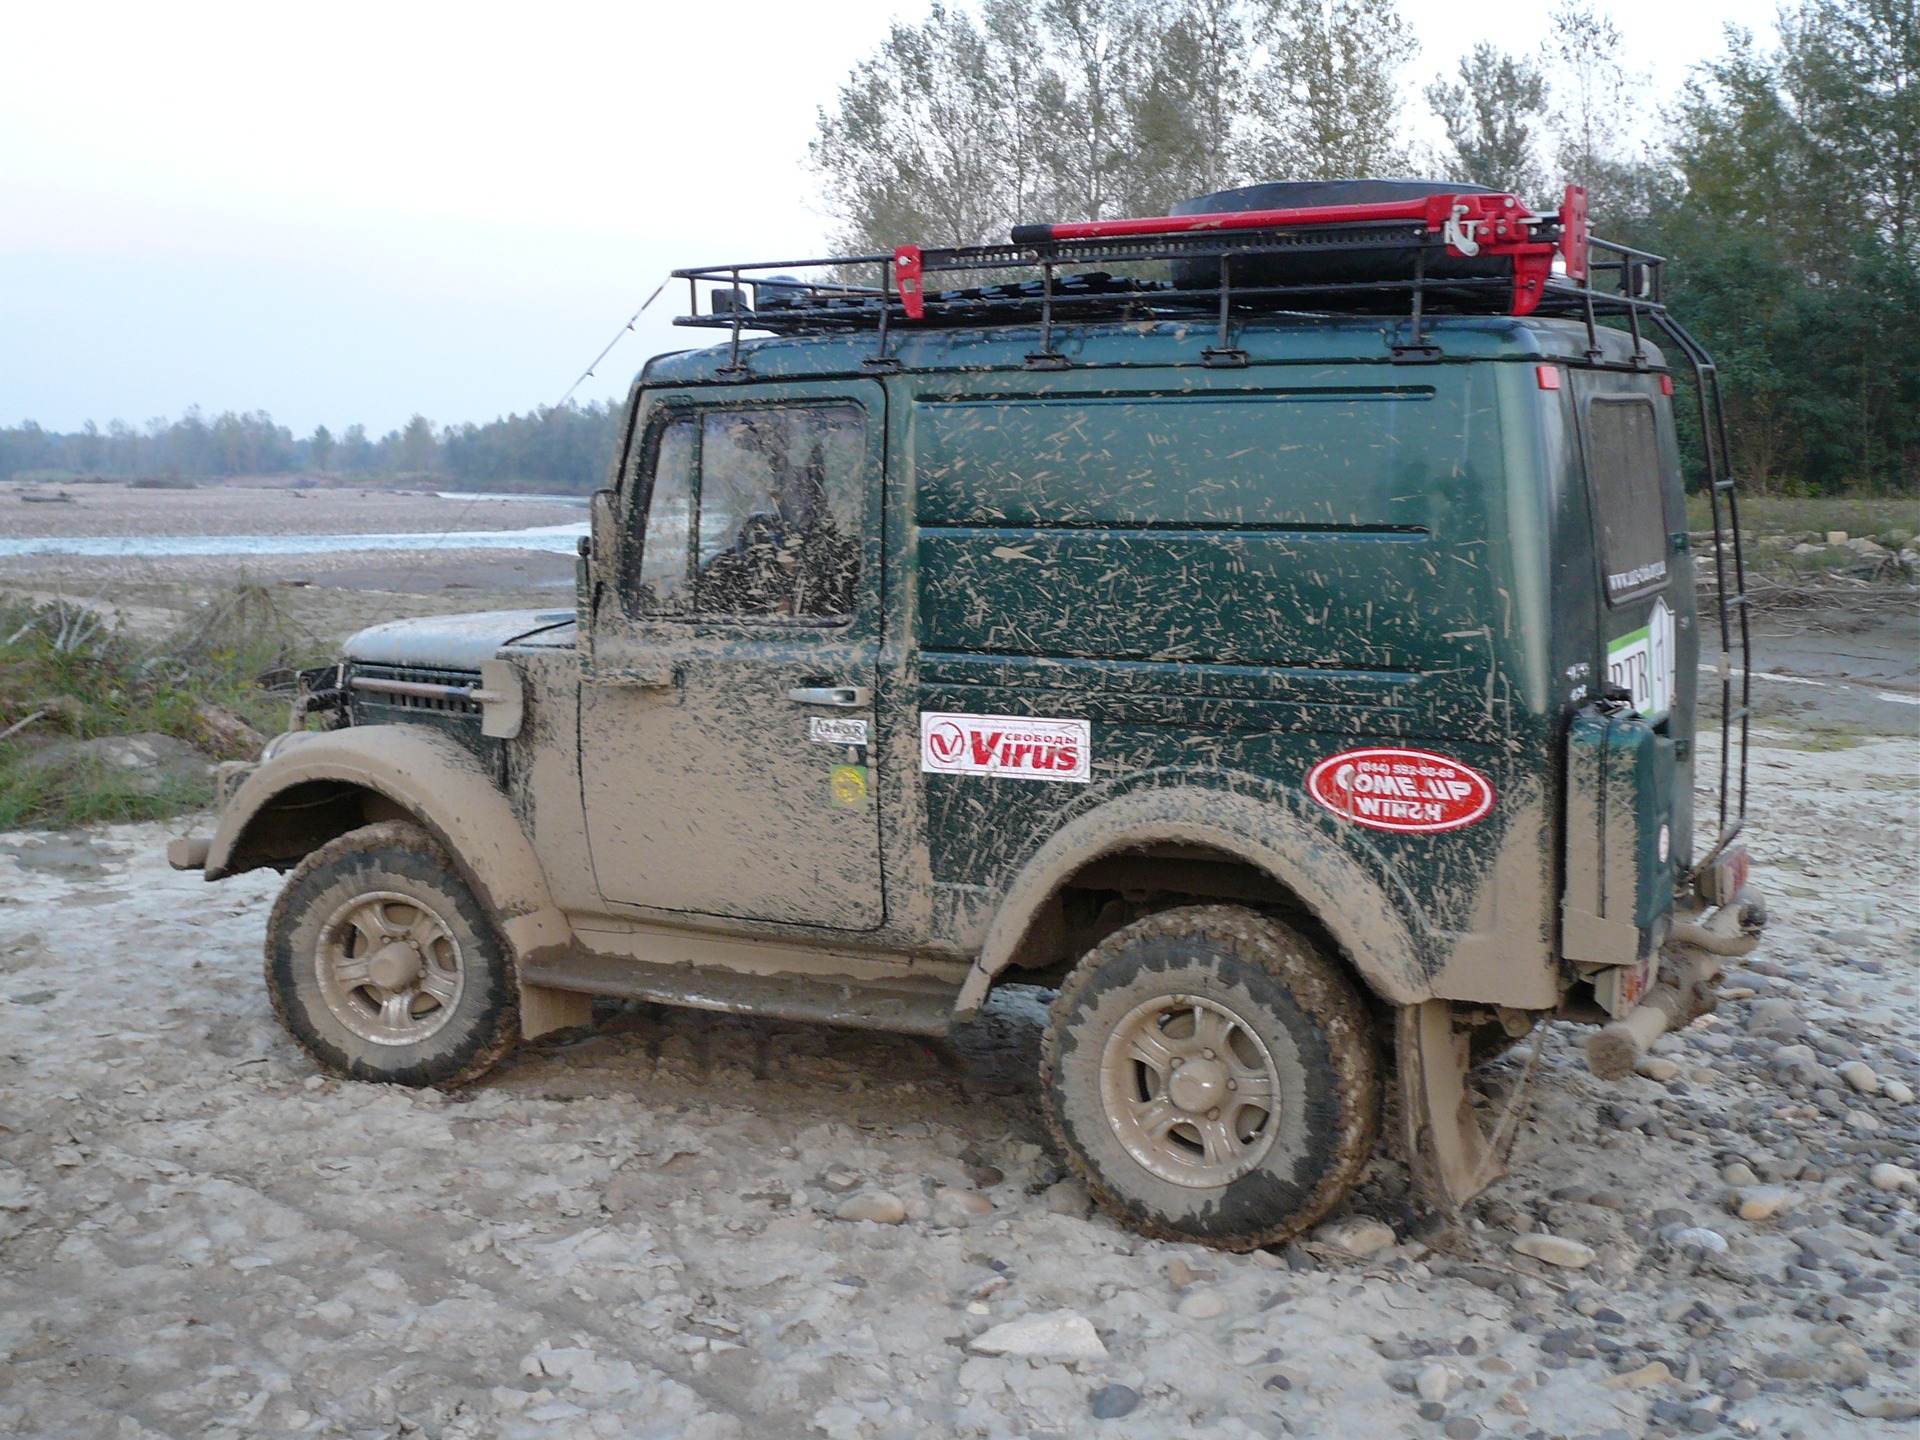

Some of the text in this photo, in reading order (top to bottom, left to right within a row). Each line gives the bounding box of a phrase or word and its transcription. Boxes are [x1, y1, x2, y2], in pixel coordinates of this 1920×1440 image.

[969, 730, 1079, 771] Virus
[1004, 732, 1078, 745] СВОБОДЫ
[1353, 797, 1442, 821] WINCH
